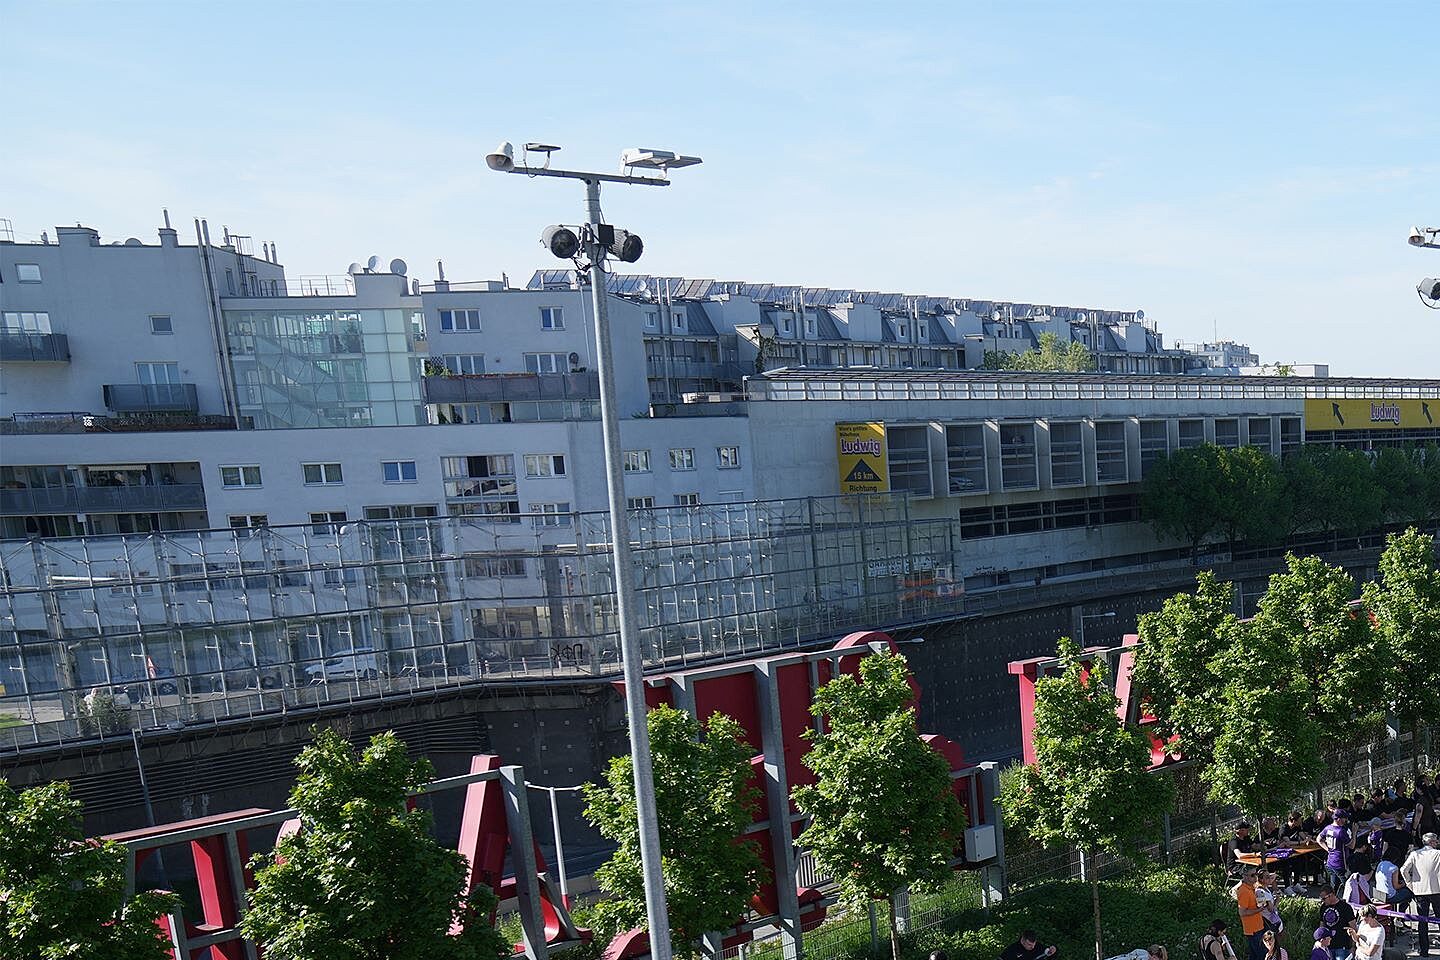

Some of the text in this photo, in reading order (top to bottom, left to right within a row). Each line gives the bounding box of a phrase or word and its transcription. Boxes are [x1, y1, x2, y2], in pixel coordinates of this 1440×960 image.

[1371, 402, 1400, 425] Ludwig
[840, 437, 882, 457] Ludwig
[853, 471, 874, 480] 15 km
[849, 484, 878, 492] Richtung
